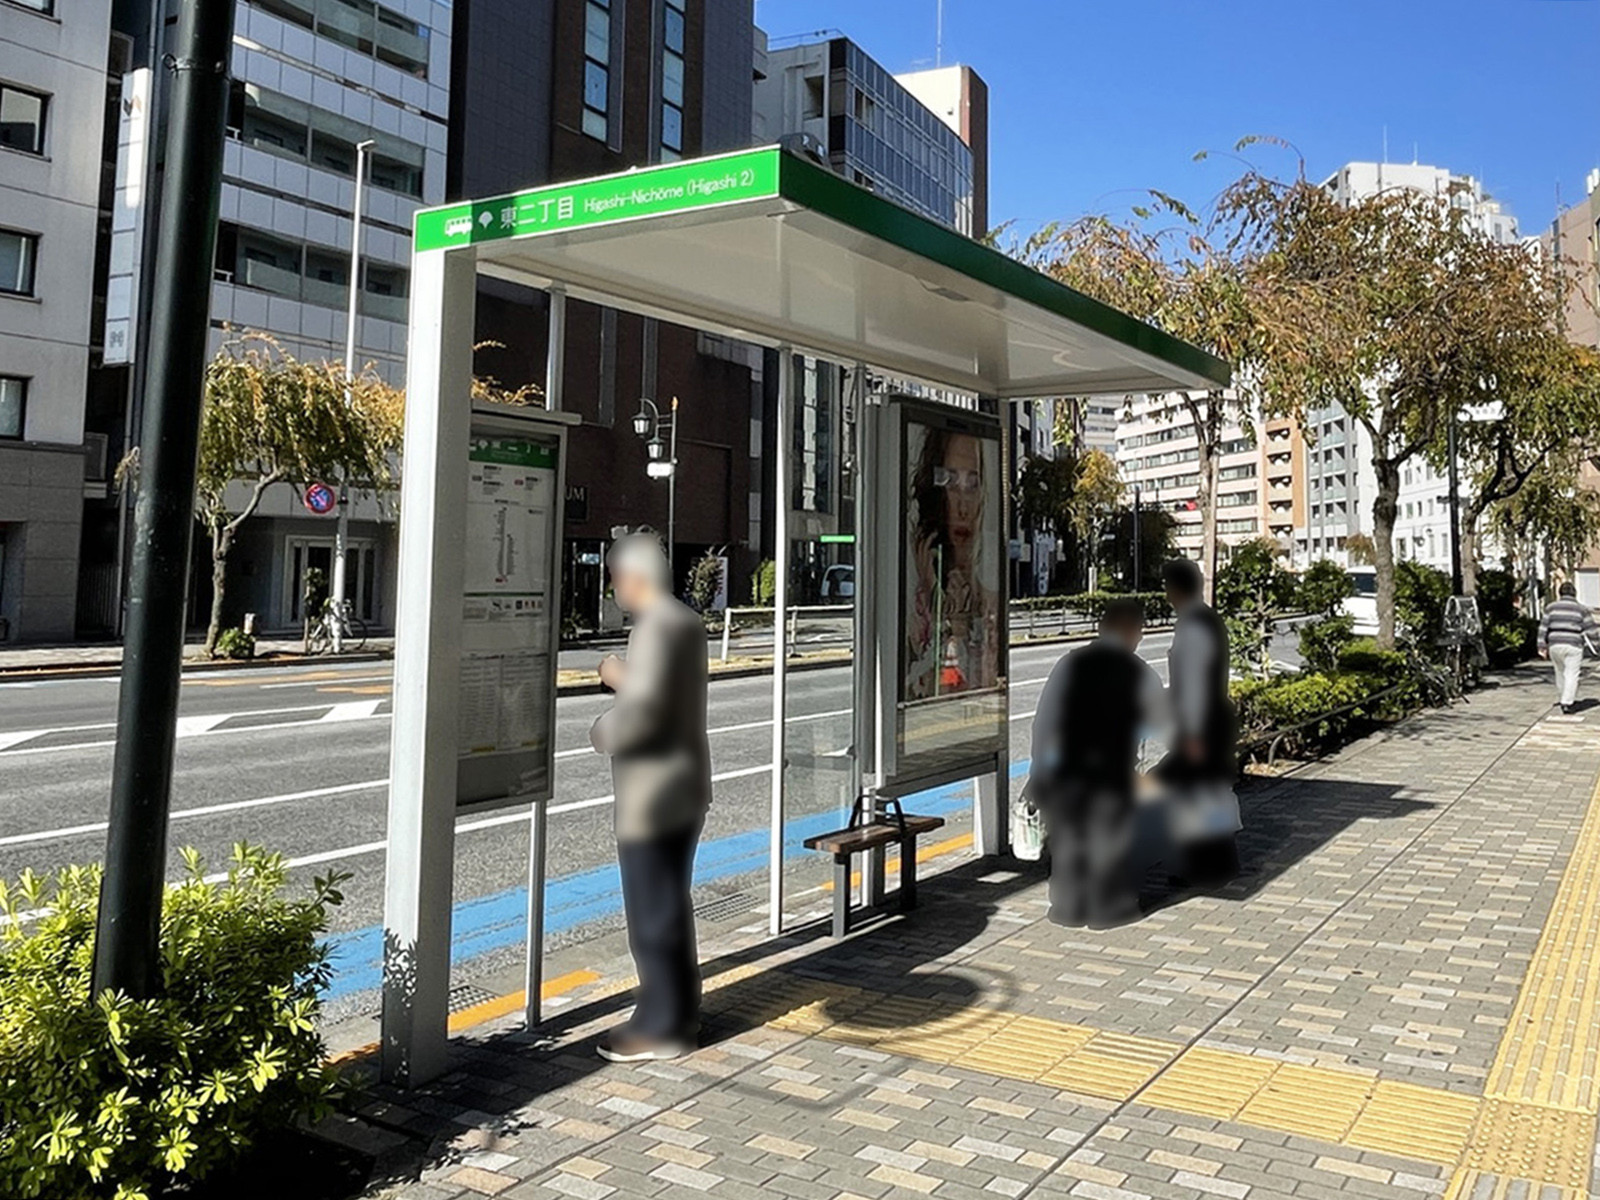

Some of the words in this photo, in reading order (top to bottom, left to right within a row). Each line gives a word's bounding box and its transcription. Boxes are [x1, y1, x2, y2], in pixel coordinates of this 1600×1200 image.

[687, 173, 737, 196] (Higashi
[740, 169, 755, 187] 2)
[500, 195, 574, 228] 東二丁目
